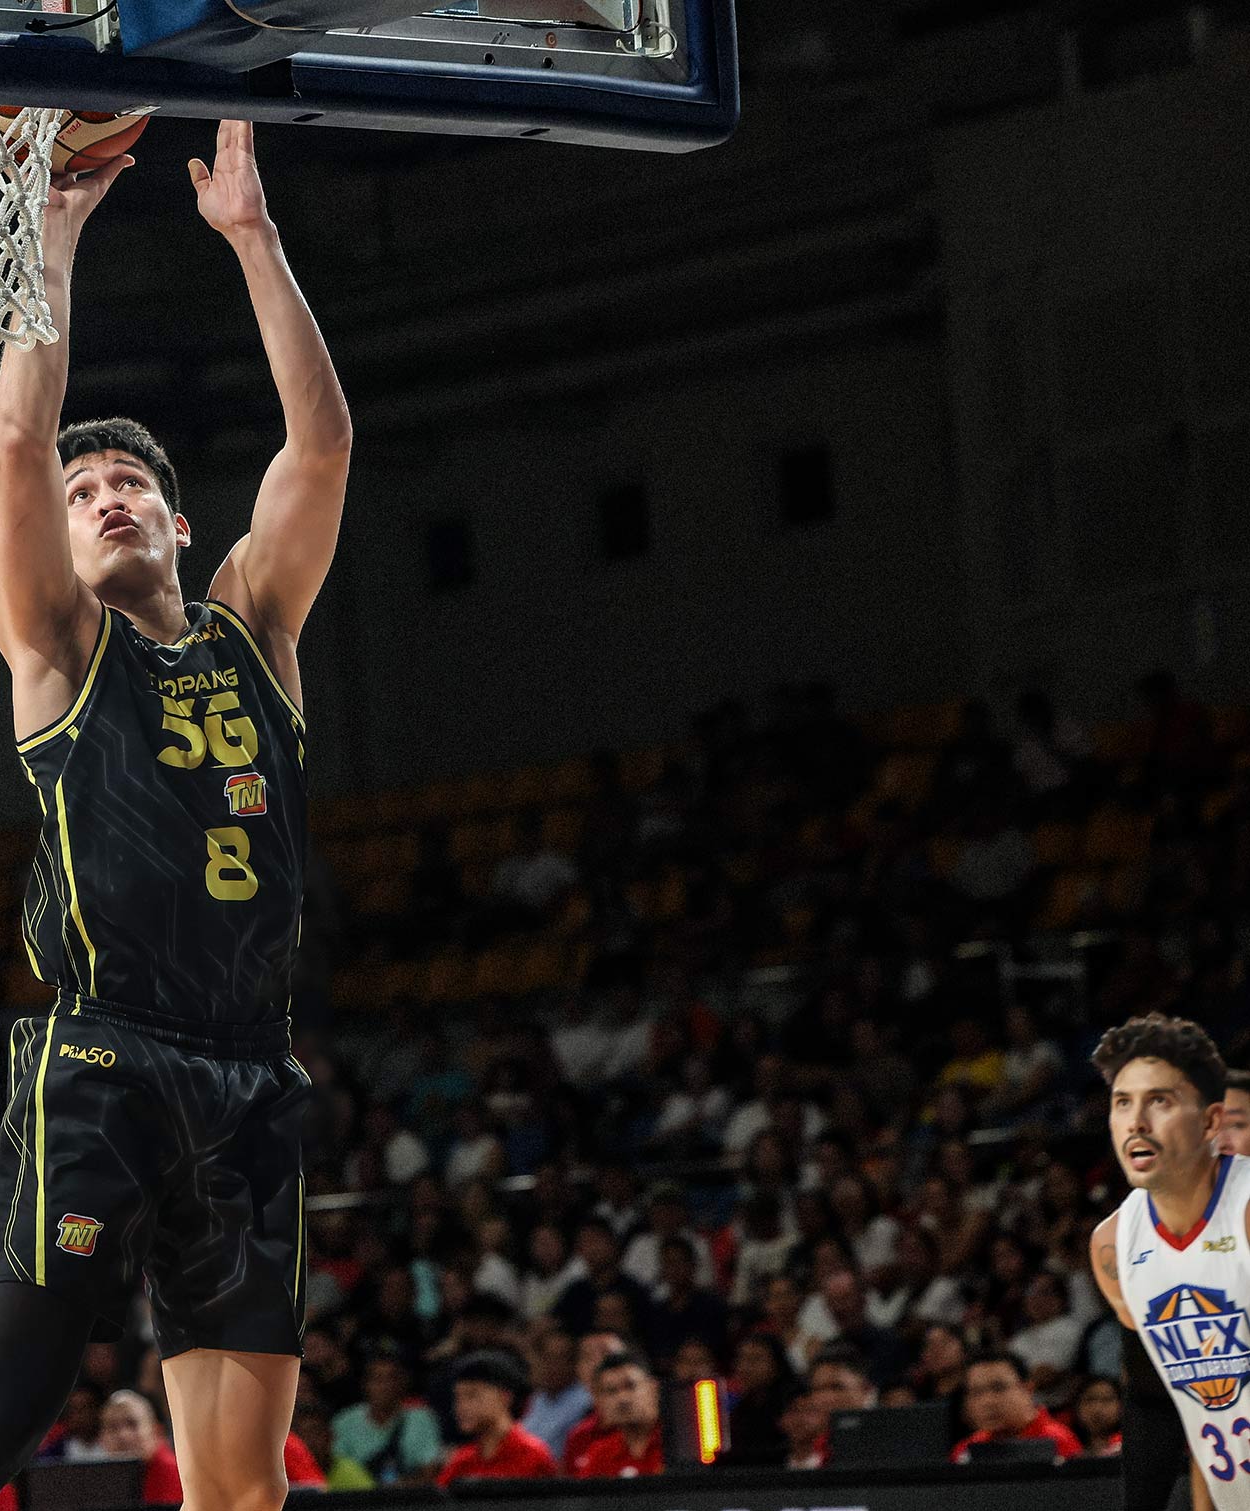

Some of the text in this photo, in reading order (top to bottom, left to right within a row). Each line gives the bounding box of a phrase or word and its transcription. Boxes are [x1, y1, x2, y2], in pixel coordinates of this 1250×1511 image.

[156, 690, 260, 770] 5G
[226, 776, 267, 815] TNT
[204, 824, 260, 901] 8
[59, 1220, 104, 1248] TNT
[1150, 1314, 1250, 1364] NLEX
